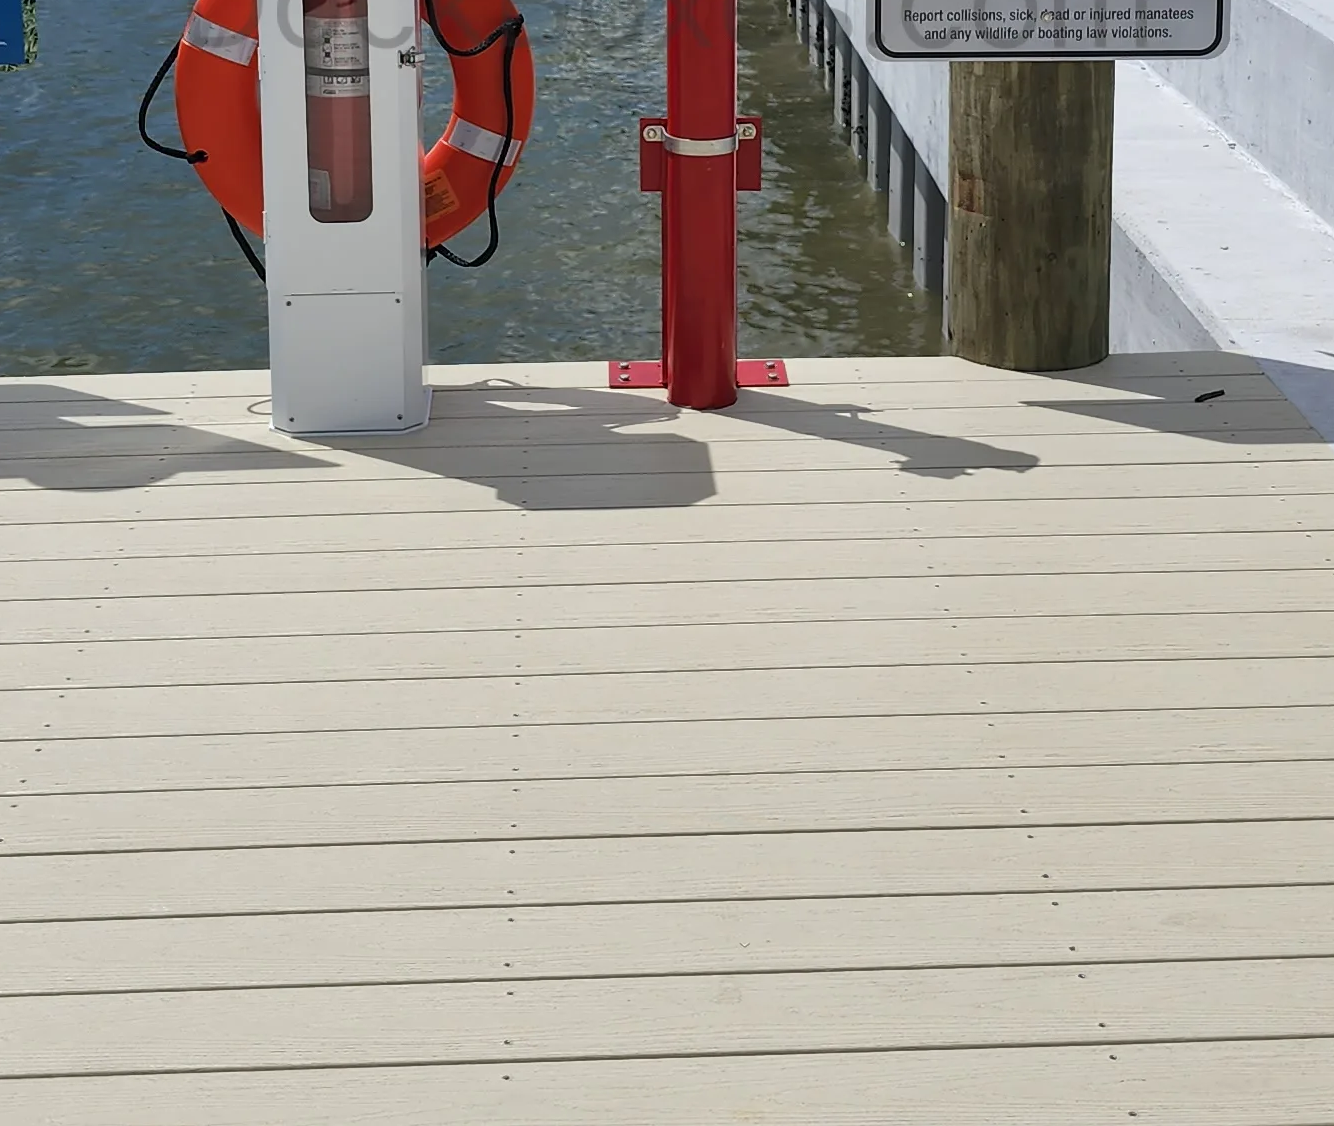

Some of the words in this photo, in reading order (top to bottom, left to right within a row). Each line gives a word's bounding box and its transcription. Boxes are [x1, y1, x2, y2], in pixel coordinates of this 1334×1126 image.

[904, 9, 943, 24] Report
[946, 8, 1006, 23] collisions,
[1009, 8, 1037, 23] sick,
[1074, 10, 1086, 21] or
[1089, 8, 1131, 22] injured
[1134, 9, 1194, 20] manatees
[924, 28, 947, 40] and
[950, 29, 972, 43] any
[975, 26, 1018, 40] wildlife
[1022, 28, 1034, 39] or
[1038, 26, 1083, 42] boating
[1087, 25, 1108, 38] law
[1111, 25, 1172, 38] violations.
